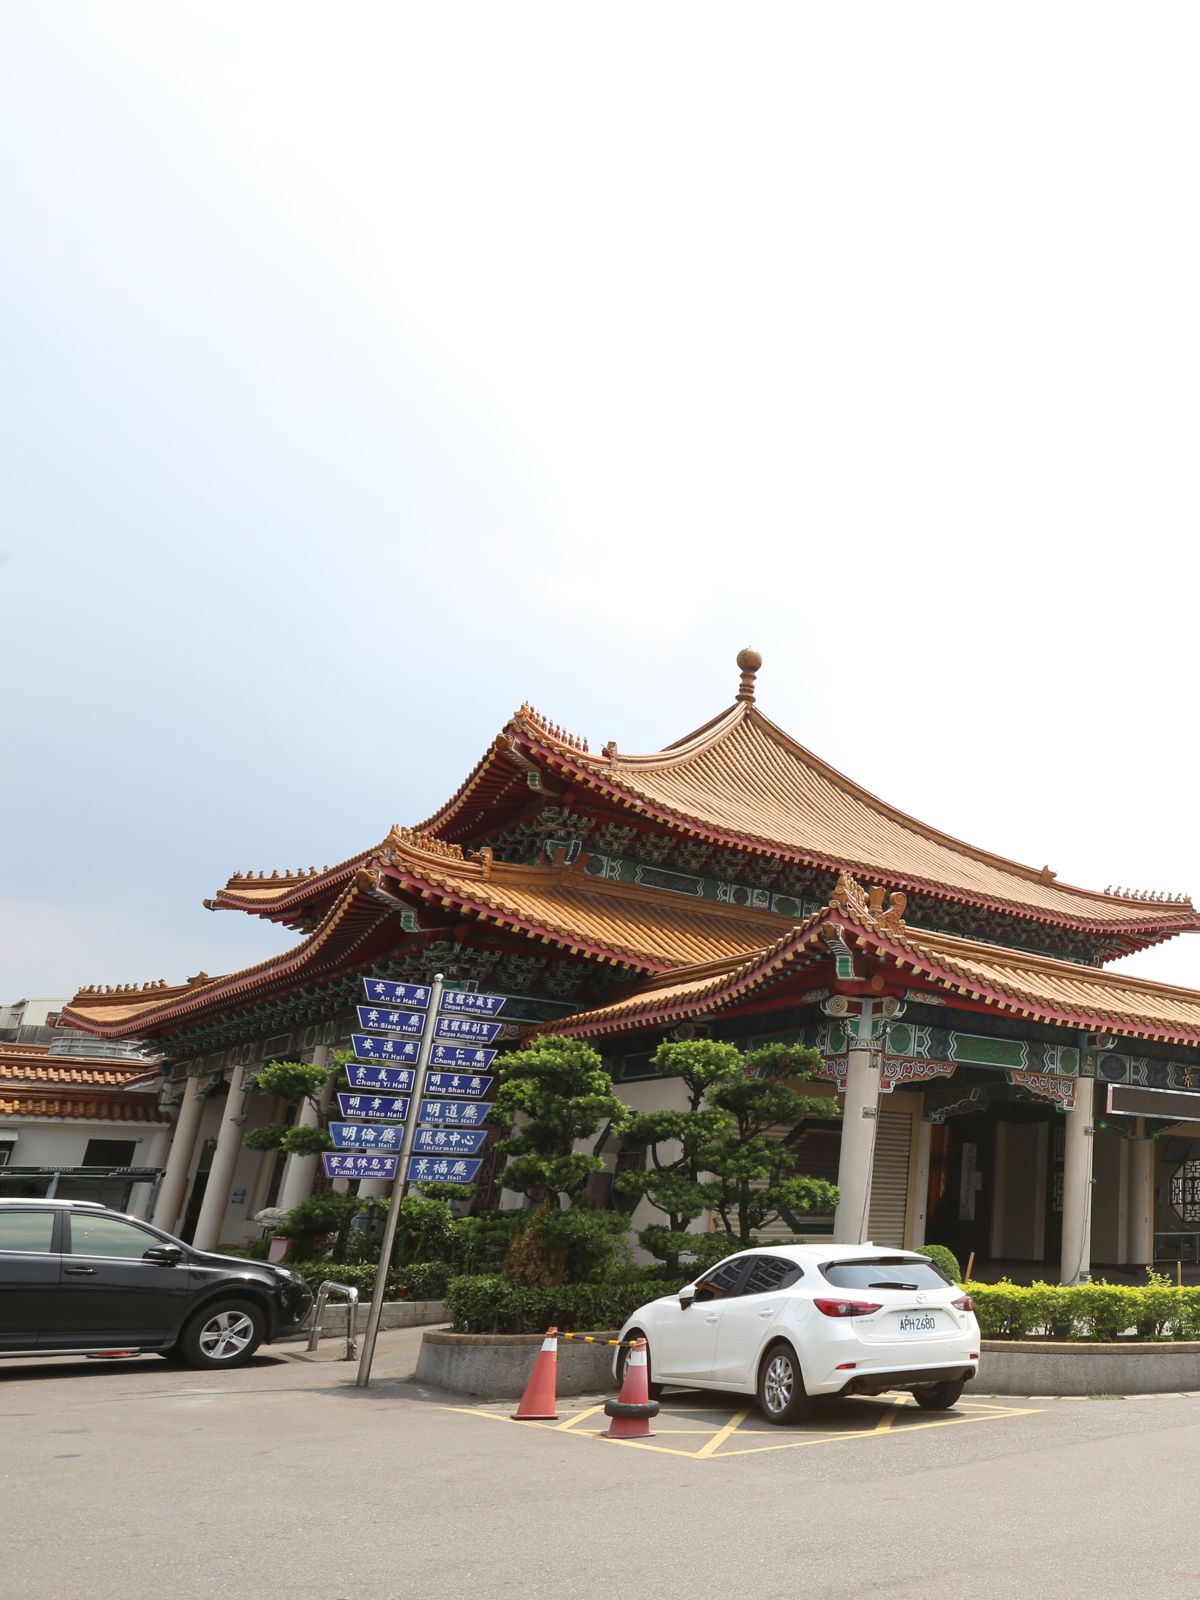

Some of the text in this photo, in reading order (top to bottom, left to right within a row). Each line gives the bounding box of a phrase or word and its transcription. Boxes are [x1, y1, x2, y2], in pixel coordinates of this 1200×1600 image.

[374, 982, 425, 999] 安樂廳
[444, 1003, 461, 1011] Corpse
[445, 992, 495, 1008] 遺體冷藏室
[367, 1009, 419, 1026] 安祥廳
[380, 1023, 400, 1031] Siang
[439, 1030, 456, 1038] Corpse
[440, 1019, 490, 1034] 遺體解剖室
[435, 1046, 485, 1061] 崇仁廳
[434, 1057, 456, 1066] Chong
[356, 1066, 409, 1083] 崇義廳
[431, 1074, 481, 1088] 明善廳
[356, 1079, 380, 1088] Chong
[429, 1085, 446, 1093] Ming
[349, 1096, 404, 1111] 明孝廳
[426, 1103, 478, 1119] 明道廳
[347, 1108, 366, 1117] Ming
[342, 1126, 396, 1143] 明倫廳
[419, 1131, 475, 1146] 服務中心
[330, 1156, 395, 1169] 家屬休息室
[414, 1159, 468, 1176] 景福廳
[335, 1168, 359, 1176] Family
